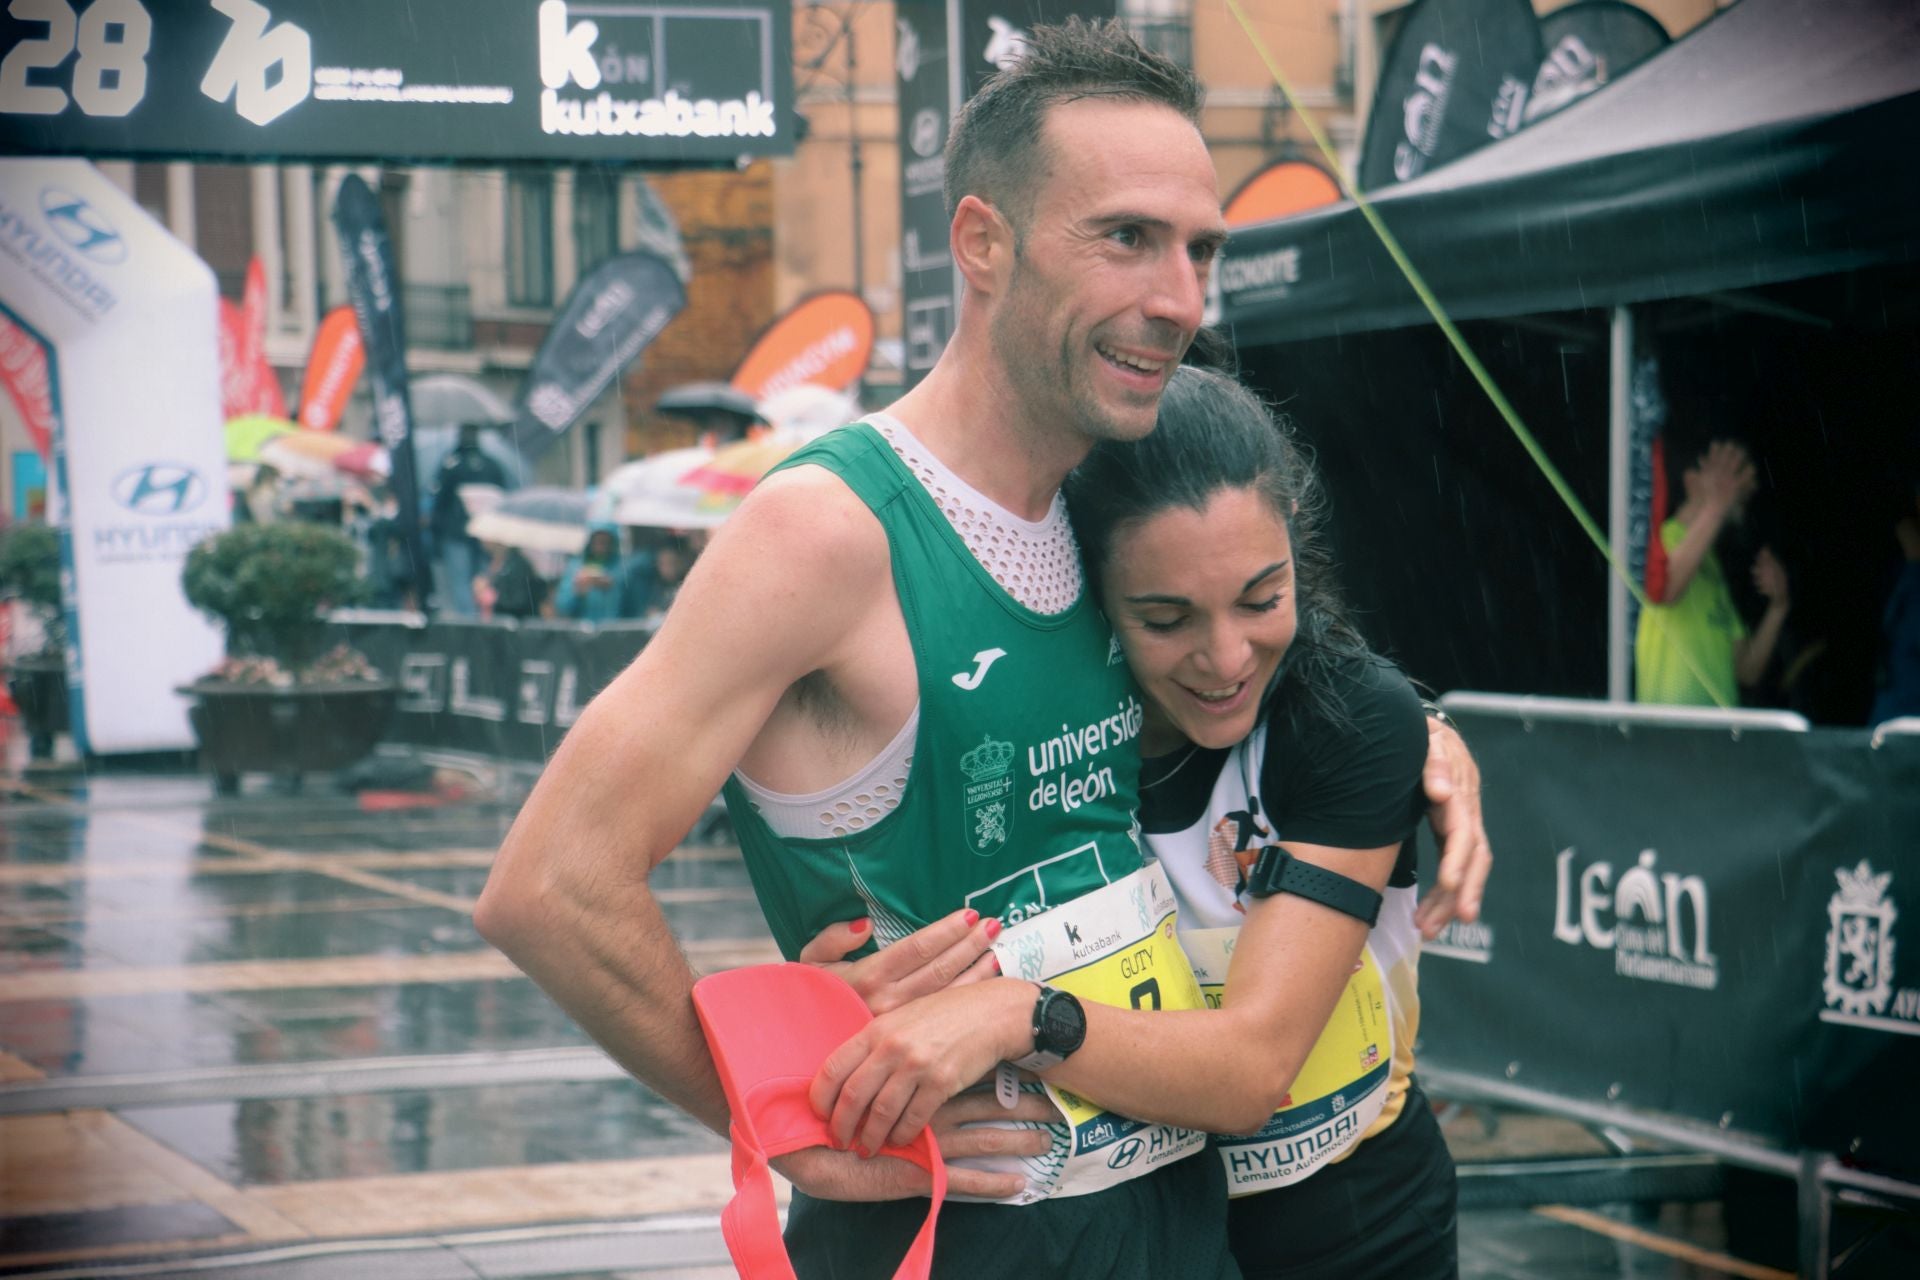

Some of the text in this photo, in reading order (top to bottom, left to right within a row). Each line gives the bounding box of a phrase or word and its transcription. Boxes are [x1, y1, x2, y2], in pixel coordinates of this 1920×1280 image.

[0, 0, 152, 117] 28
[541, 88, 776, 137] kutxabank
[1028, 696, 1144, 777] universida
[1029, 762, 1116, 813] de león
[1064, 921, 1082, 946] k
[1072, 930, 1122, 960] kutxabank
[1121, 946, 1154, 979] GUTY
[1229, 1111, 1358, 1173] HYUNDAI
[1234, 1129, 1359, 1184] Lemauto Automoción
